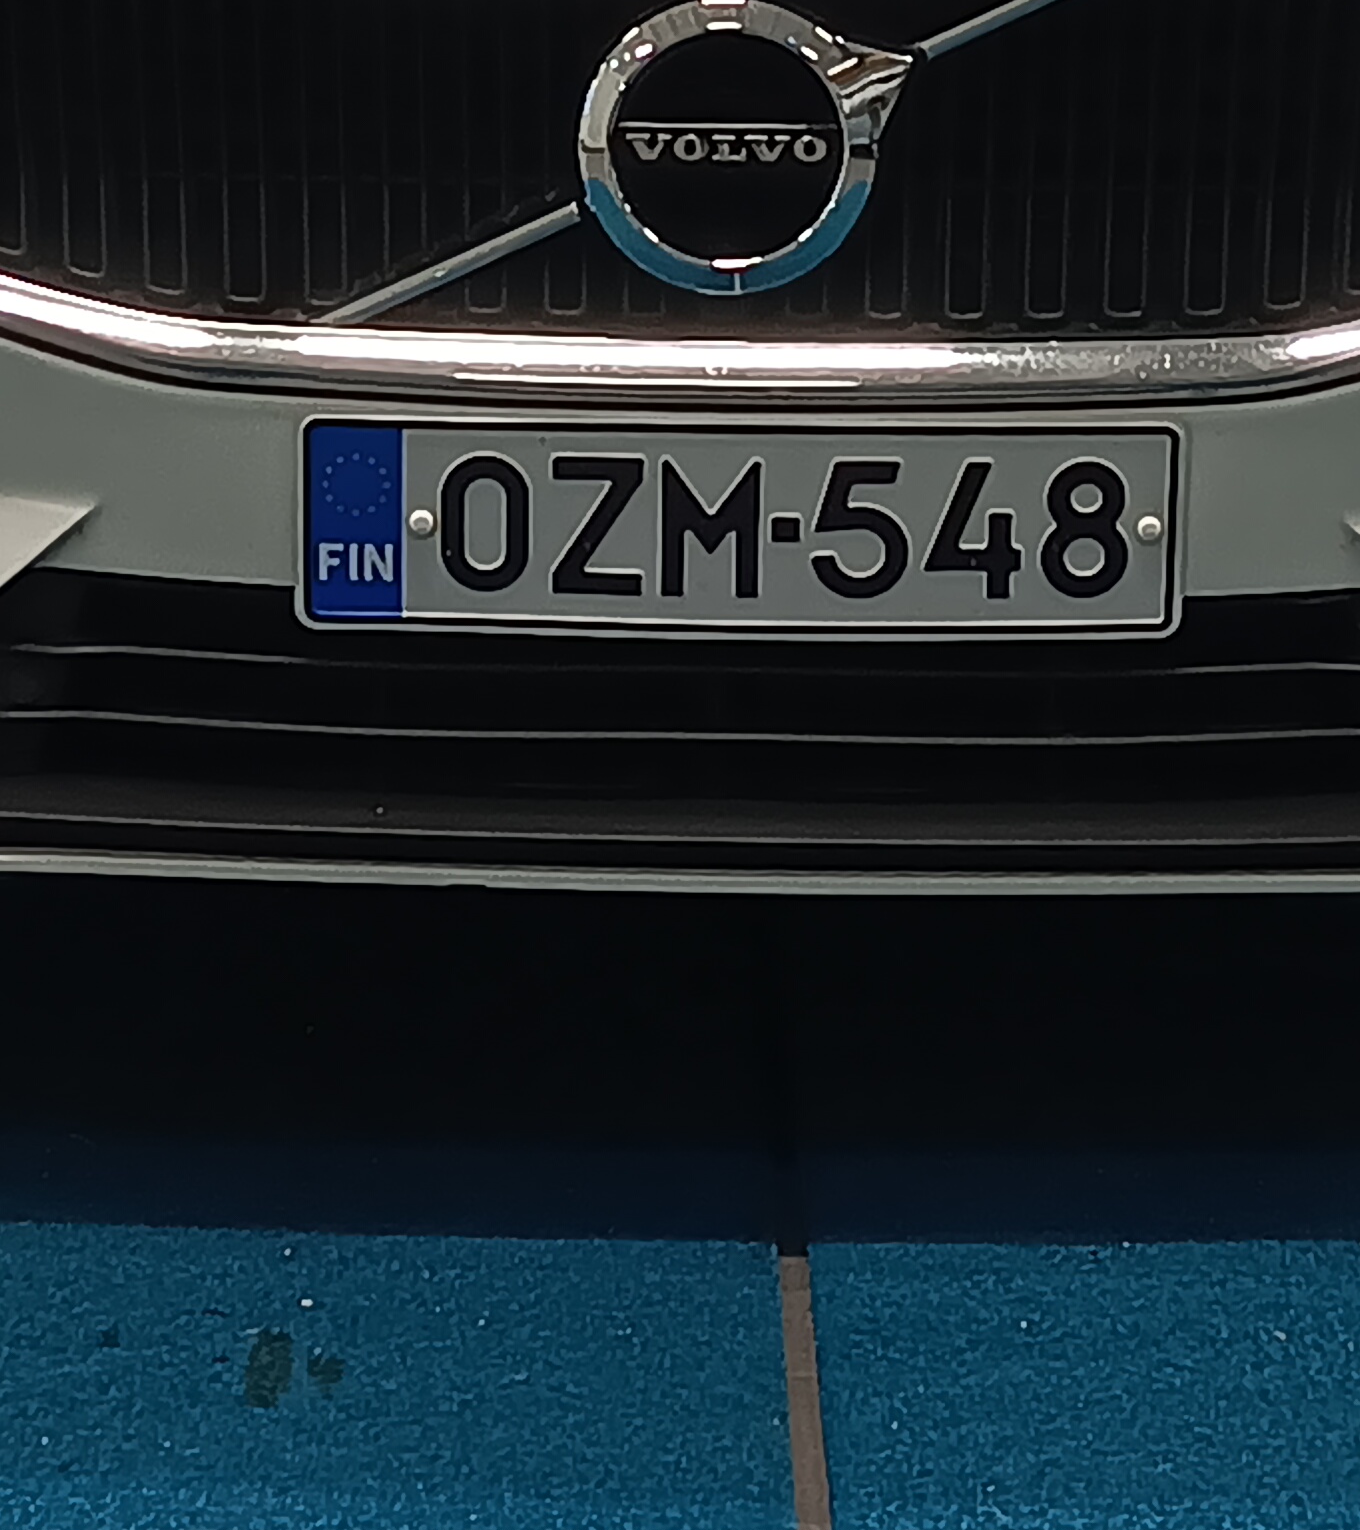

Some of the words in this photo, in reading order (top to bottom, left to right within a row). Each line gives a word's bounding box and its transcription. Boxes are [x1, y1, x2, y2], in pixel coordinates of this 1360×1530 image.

[626, 132, 828, 163] VOLVO
[437, 451, 1130, 600] OZM-548
[316, 542, 395, 583] FIN
